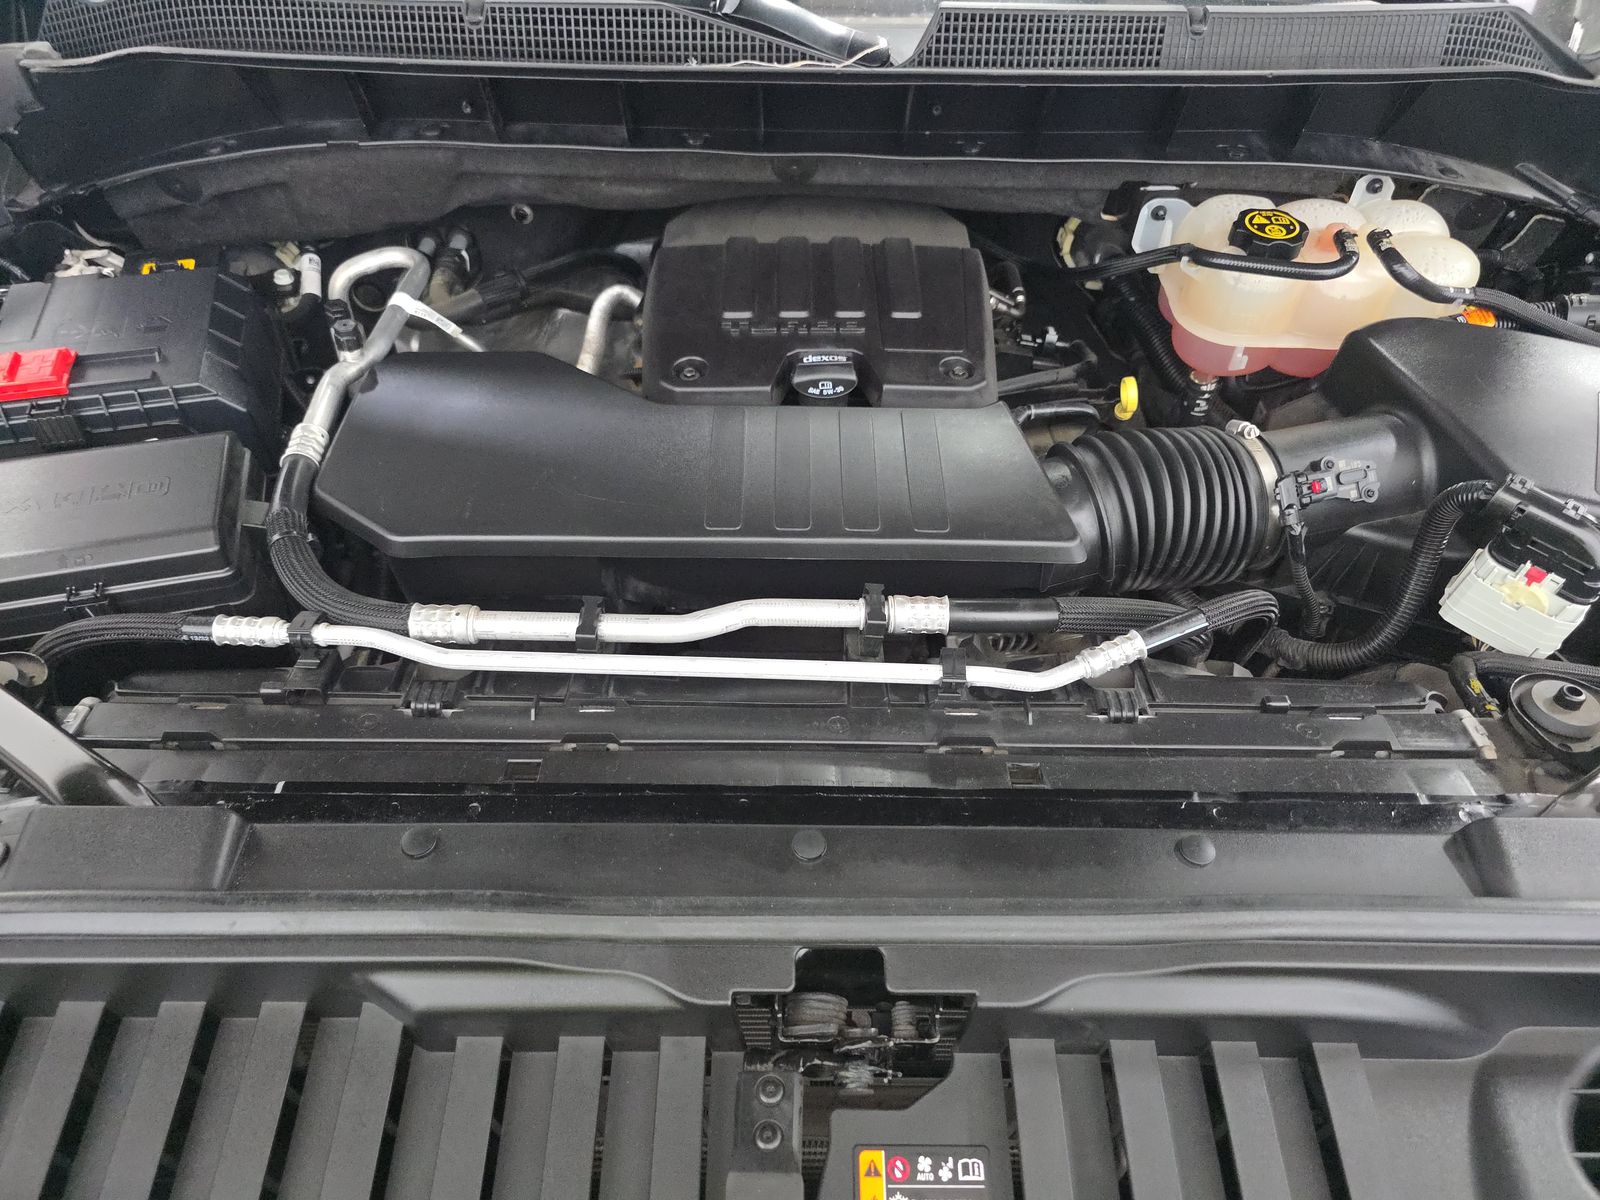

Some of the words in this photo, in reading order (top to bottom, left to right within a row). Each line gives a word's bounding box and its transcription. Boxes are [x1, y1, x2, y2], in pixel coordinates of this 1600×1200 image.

[803, 355, 847, 363] dexos
[808, 387, 820, 395] SAE
[916, 1172, 935, 1182] AUTO
